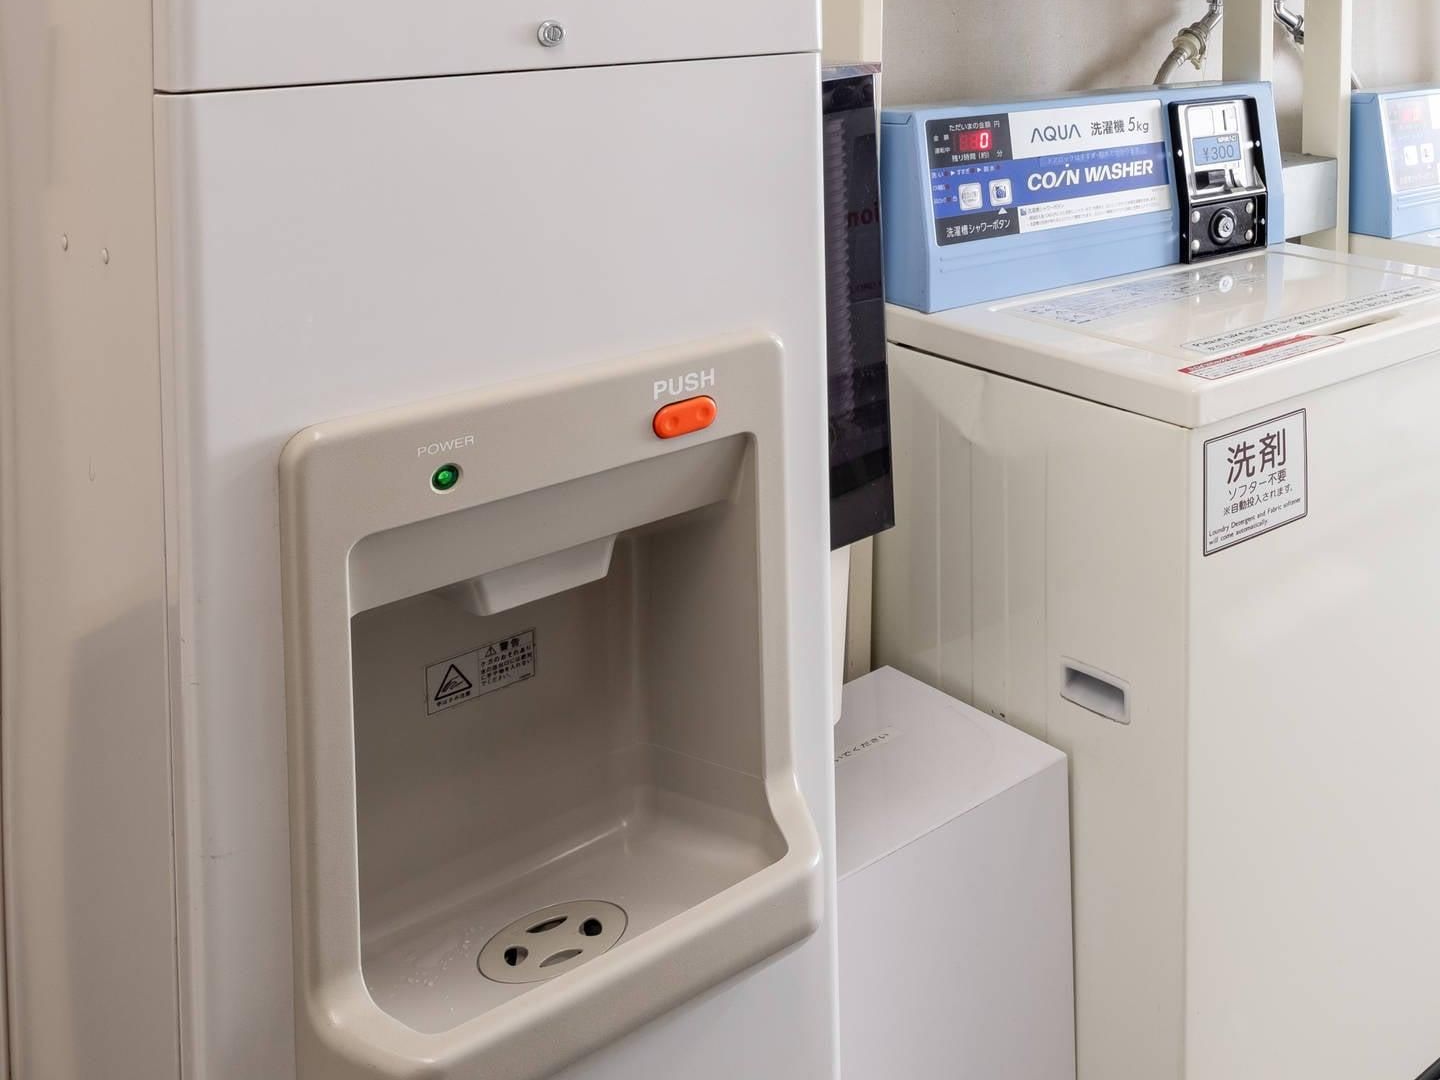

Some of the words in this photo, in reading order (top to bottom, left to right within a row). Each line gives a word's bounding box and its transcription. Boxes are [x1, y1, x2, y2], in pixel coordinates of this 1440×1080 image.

[980, 132, 989, 149] 0
[1031, 123, 1081, 143] AQUA
[1090, 119, 1125, 136] 洗濯機
[1128, 116, 1149, 133] 5kg
[1202, 144, 1235, 161] ¥300
[1027, 163, 1080, 191] COIN
[1085, 159, 1154, 183] WASHER
[653, 368, 715, 401] PUSH
[417, 435, 475, 458] POWER
[1227, 428, 1286, 485] 洗剤
[1228, 468, 1287, 501] ソフター不要
[1208, 525, 1229, 537] Laundry
[1257, 510, 1266, 518] and
